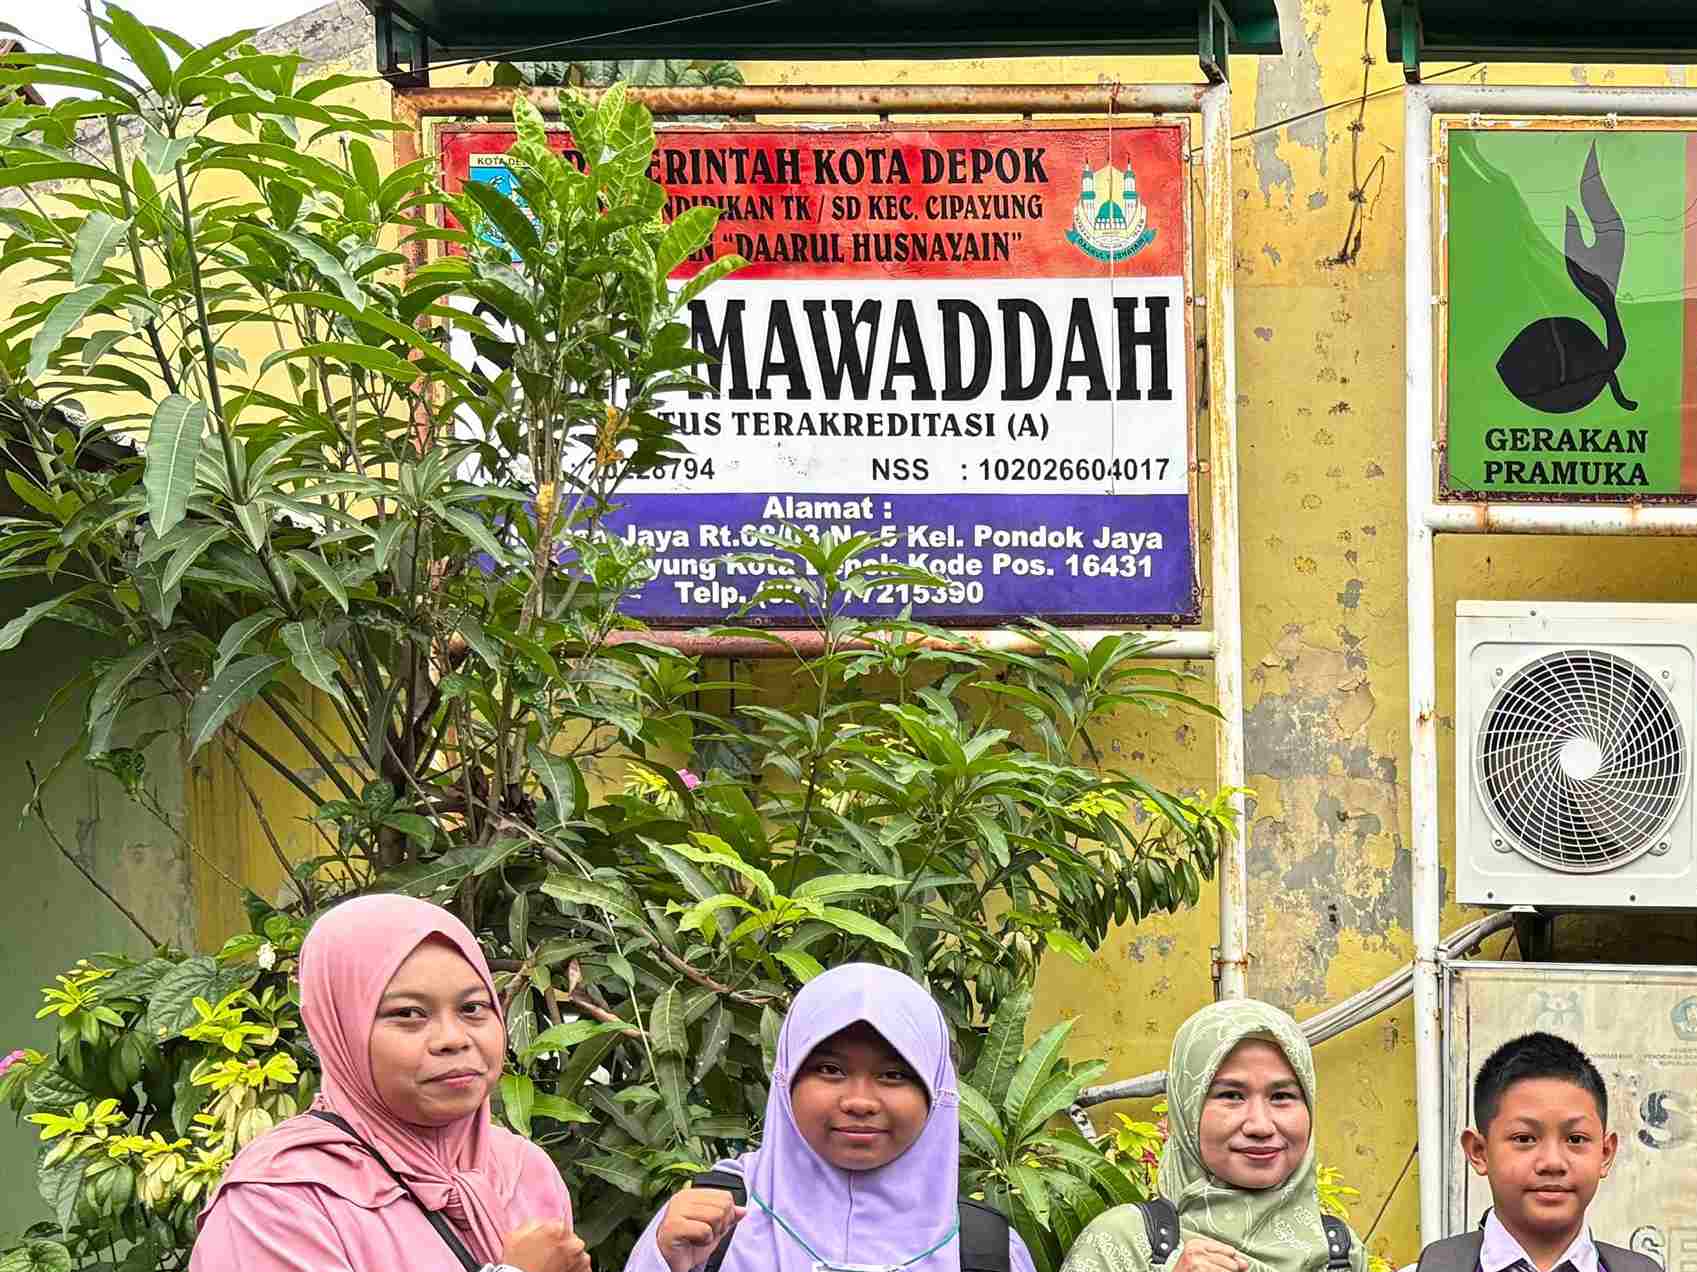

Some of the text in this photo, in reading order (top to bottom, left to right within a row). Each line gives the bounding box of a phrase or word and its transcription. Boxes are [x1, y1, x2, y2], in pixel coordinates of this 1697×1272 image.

[562, 148, 1049, 186] ERINTAH KOTA DEPOK
[782, 196, 811, 221] TK
[831, 195, 862, 220] SD
[868, 195, 919, 221] KEC.
[925, 194, 1044, 221] CIPAYUNG
[686, 296, 1173, 403] MAWADDAH
[731, 411, 997, 440] TERAKREDITASI
[1007, 411, 1050, 442] (A)
[1484, 428, 1649, 454] GERAKAN
[871, 458, 931, 482] NSS
[979, 458, 1170, 482] 102026604017
[1483, 460, 1650, 487] PRAMUKA
[762, 495, 874, 520] Alamat
[624, 524, 690, 553] Jaya
[907, 524, 965, 549] Kel.
[973, 524, 1085, 550] Pondok
[1092, 526, 1164, 556] Jaya
[907, 553, 984, 577] Kode
[992, 553, 1055, 577] Pos.
[1065, 554, 1153, 578] 16431
[674, 580, 747, 609] Telp.
